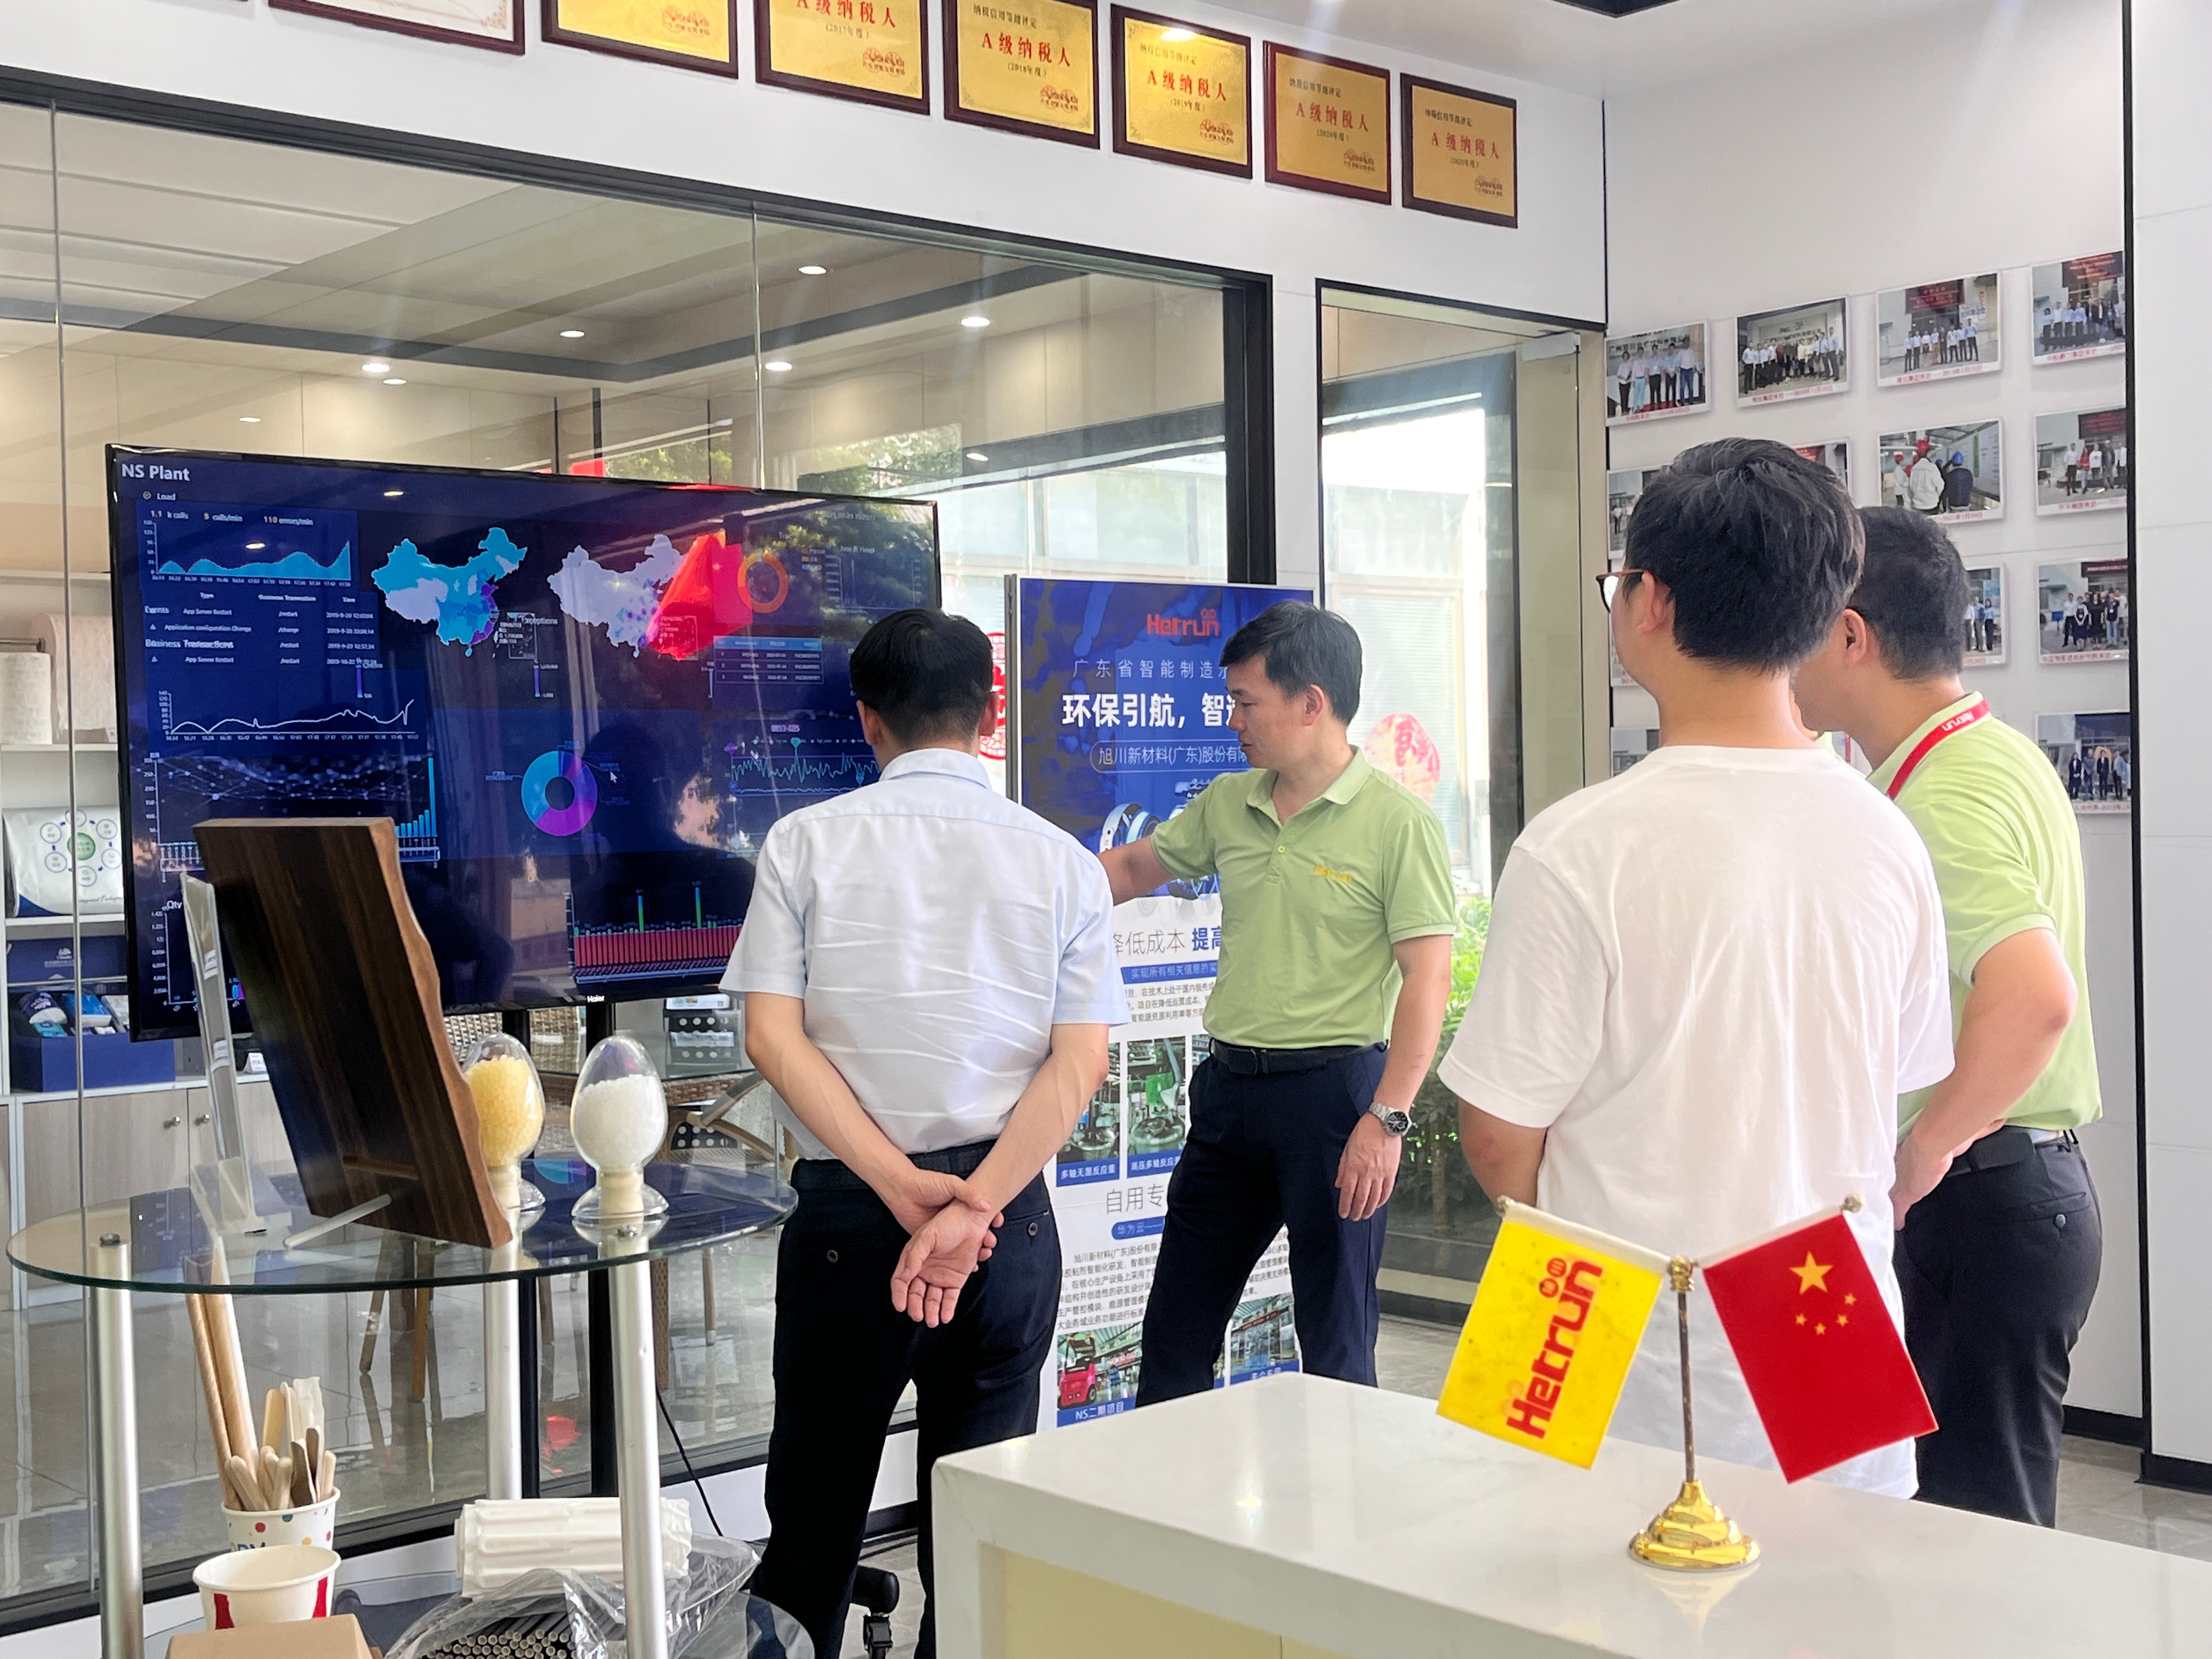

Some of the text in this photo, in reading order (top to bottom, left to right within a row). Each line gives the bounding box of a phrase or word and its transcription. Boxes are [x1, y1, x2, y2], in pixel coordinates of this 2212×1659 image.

[981, 32, 1071, 67] A级纳税人
[1147, 70, 1227, 101] A级纳税人
[1296, 102, 1368, 132] A级纳税人
[1431, 132, 1499, 159] A级纳税人
[122, 464, 190, 481] NS Plant
[145, 639, 181, 648] Business
[1107, 1183, 1165, 1215] 自用专
[1505, 1260, 1604, 1440] Hetrun
